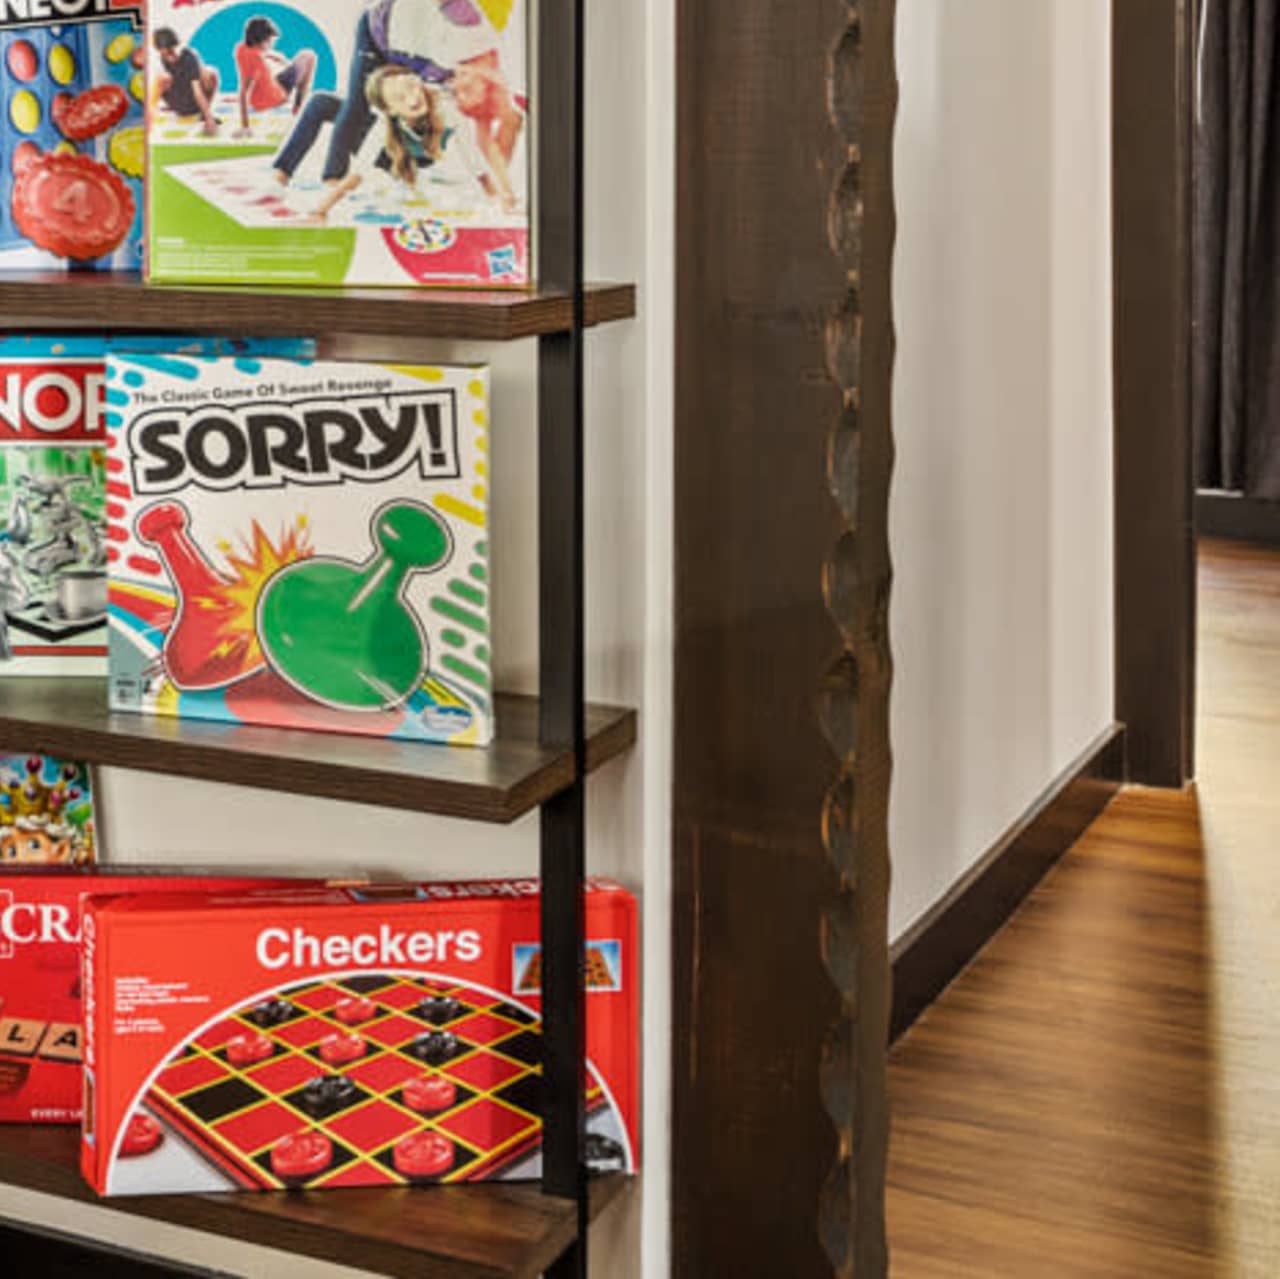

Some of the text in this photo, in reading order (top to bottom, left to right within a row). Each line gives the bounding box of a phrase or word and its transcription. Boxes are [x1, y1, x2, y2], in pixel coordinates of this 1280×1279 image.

[134, 379, 393, 404] The Classic Game Of Sweet Revenge
[138, 403, 448, 483] SORRY!
[255, 924, 483, 970] Checkers
